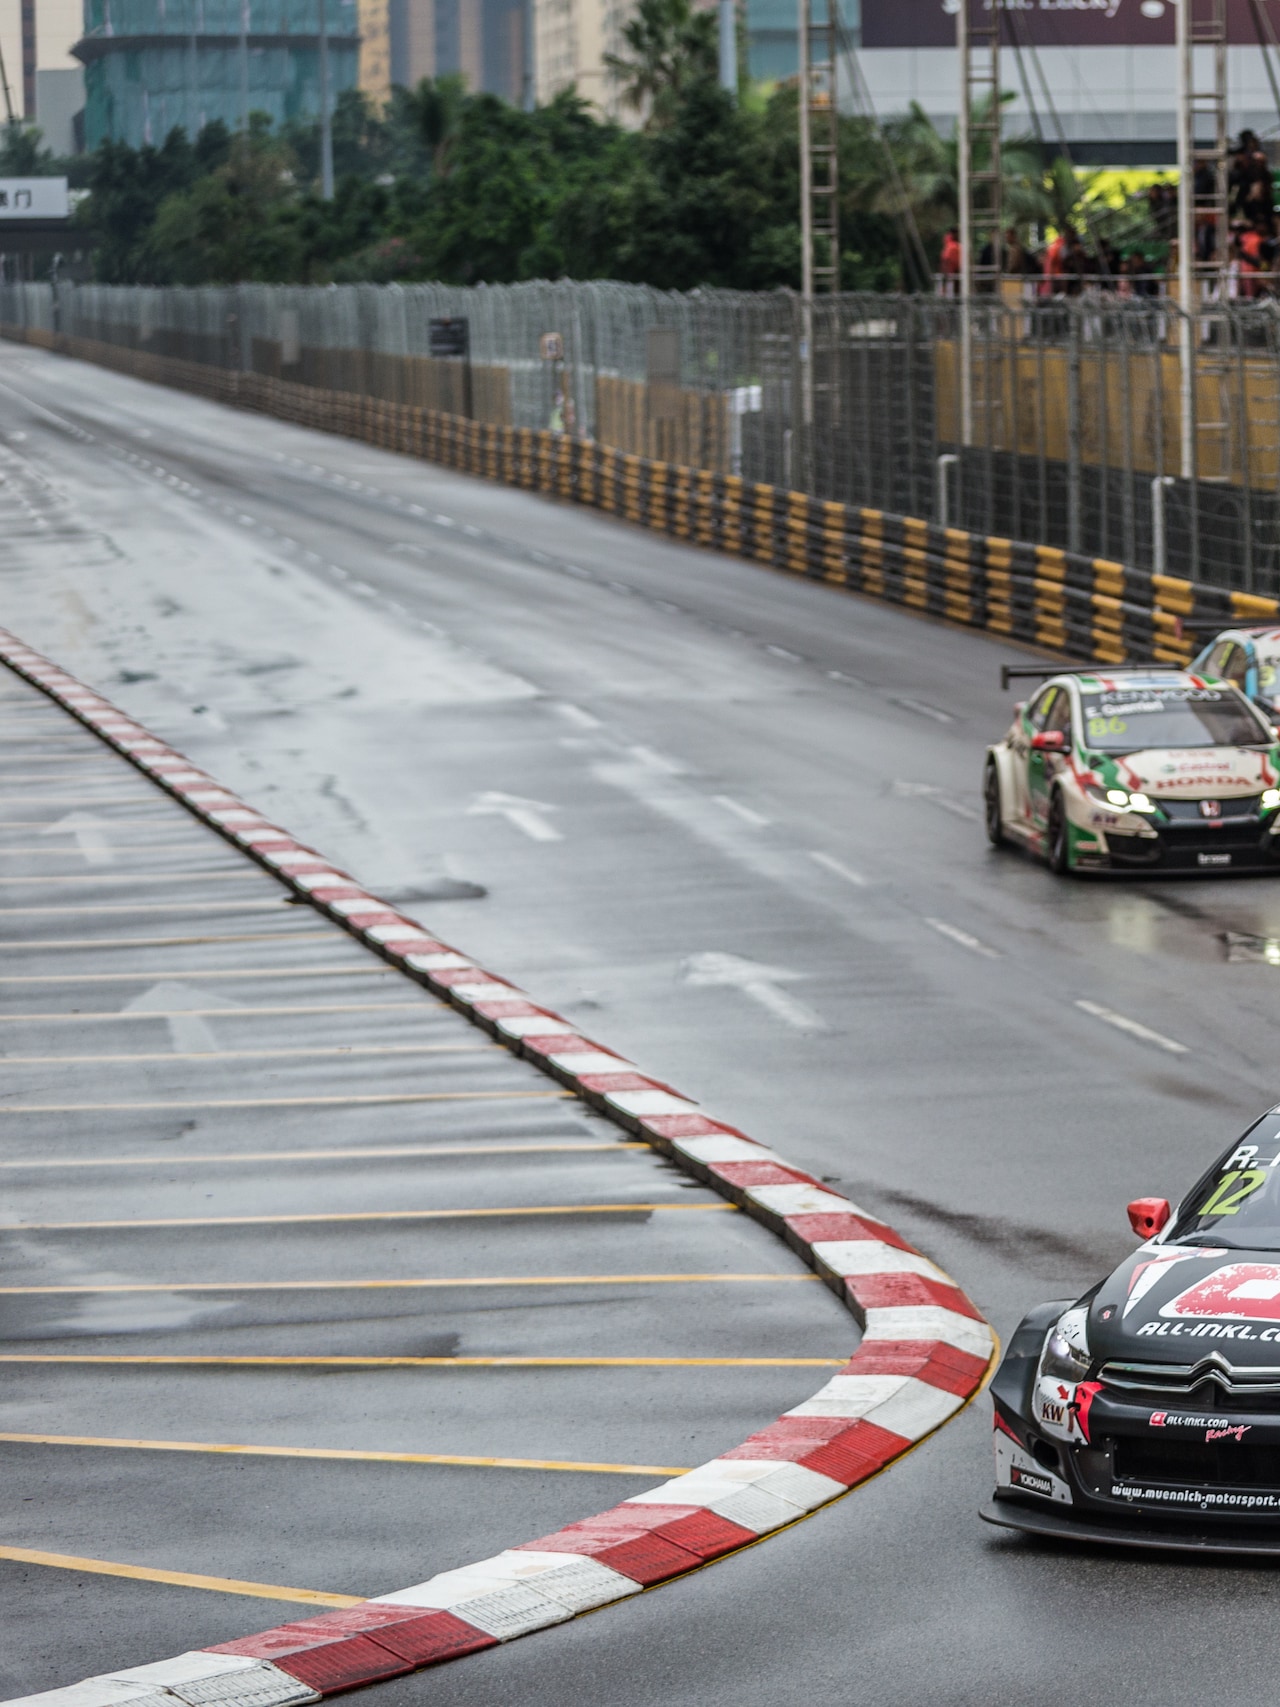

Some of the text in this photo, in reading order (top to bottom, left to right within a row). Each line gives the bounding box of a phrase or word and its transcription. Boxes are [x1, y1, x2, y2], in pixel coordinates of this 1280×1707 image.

[1258, 665, 1277, 687] 3
[1101, 689, 1221, 703] KENWOOD
[1090, 715, 1127, 737] 86
[1157, 776, 1253, 790] HONDA
[1222, 1145, 1259, 1171] R.
[1198, 1170, 1267, 1216] 12
[1041, 1402, 1064, 1422] KW
